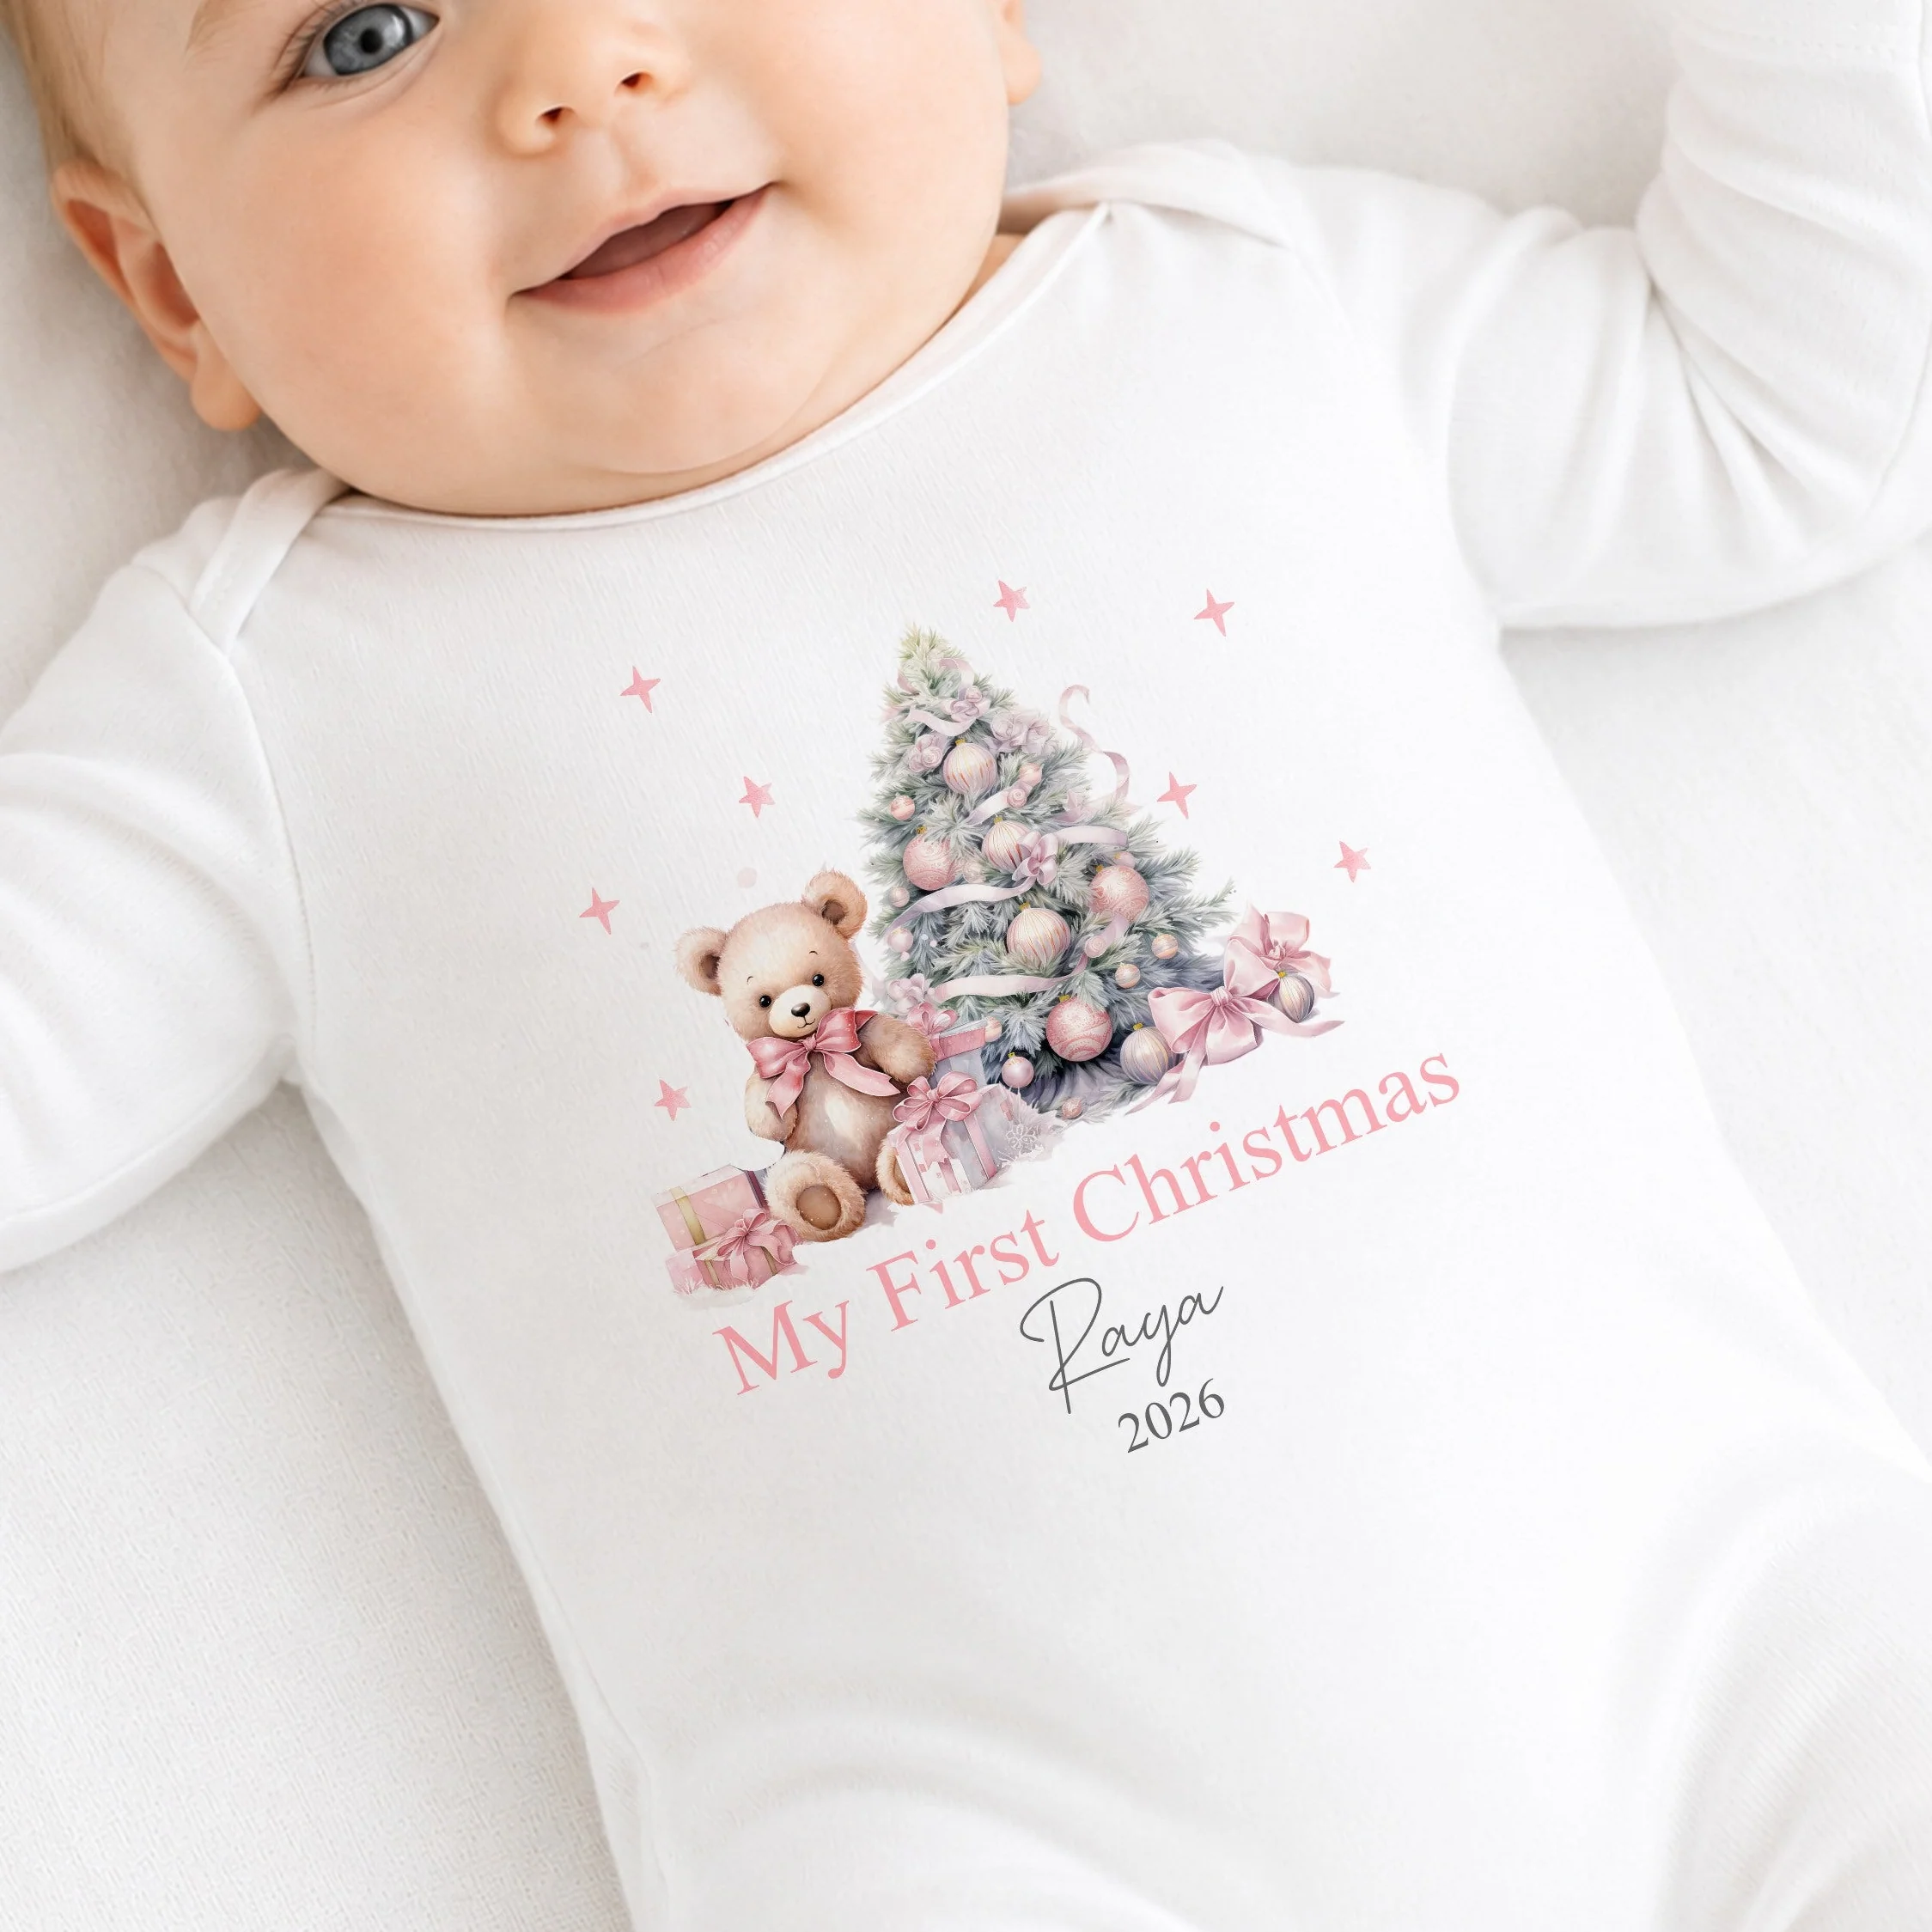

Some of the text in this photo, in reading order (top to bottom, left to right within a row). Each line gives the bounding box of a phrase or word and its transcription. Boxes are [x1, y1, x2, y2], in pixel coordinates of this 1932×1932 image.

[712, 1053, 1460, 1395] My First Christmas
[1020, 1277, 1224, 1415] Raya
[1118, 1378, 1225, 1454] 2026
